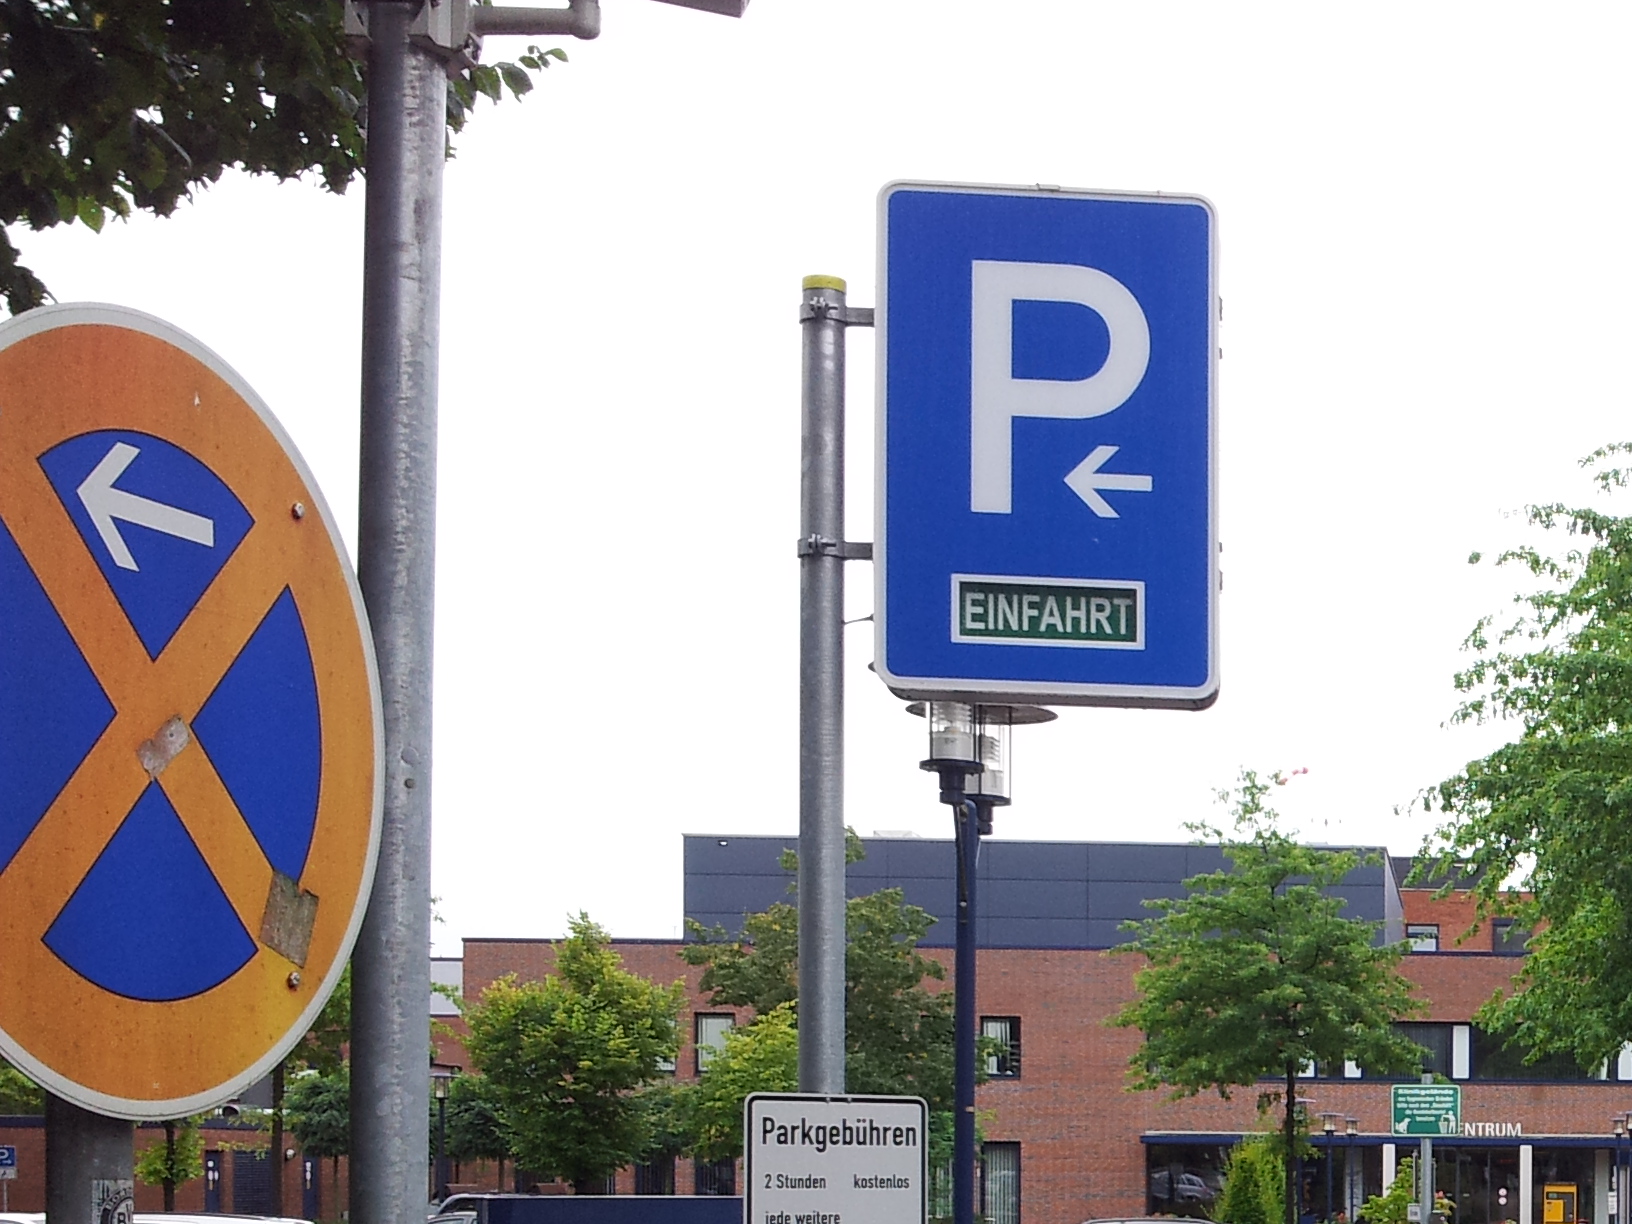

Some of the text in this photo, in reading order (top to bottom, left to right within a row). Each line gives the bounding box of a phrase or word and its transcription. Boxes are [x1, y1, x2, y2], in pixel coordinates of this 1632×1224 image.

[971, 259, 1151, 514] P
[965, 592, 1133, 635] EINFAHRT
[761, 1116, 917, 1152] Parkgebühren
[1460, 1122, 1522, 1137] NTRUM
[764, 1173, 910, 1189] 2 Stunden kostenlos
